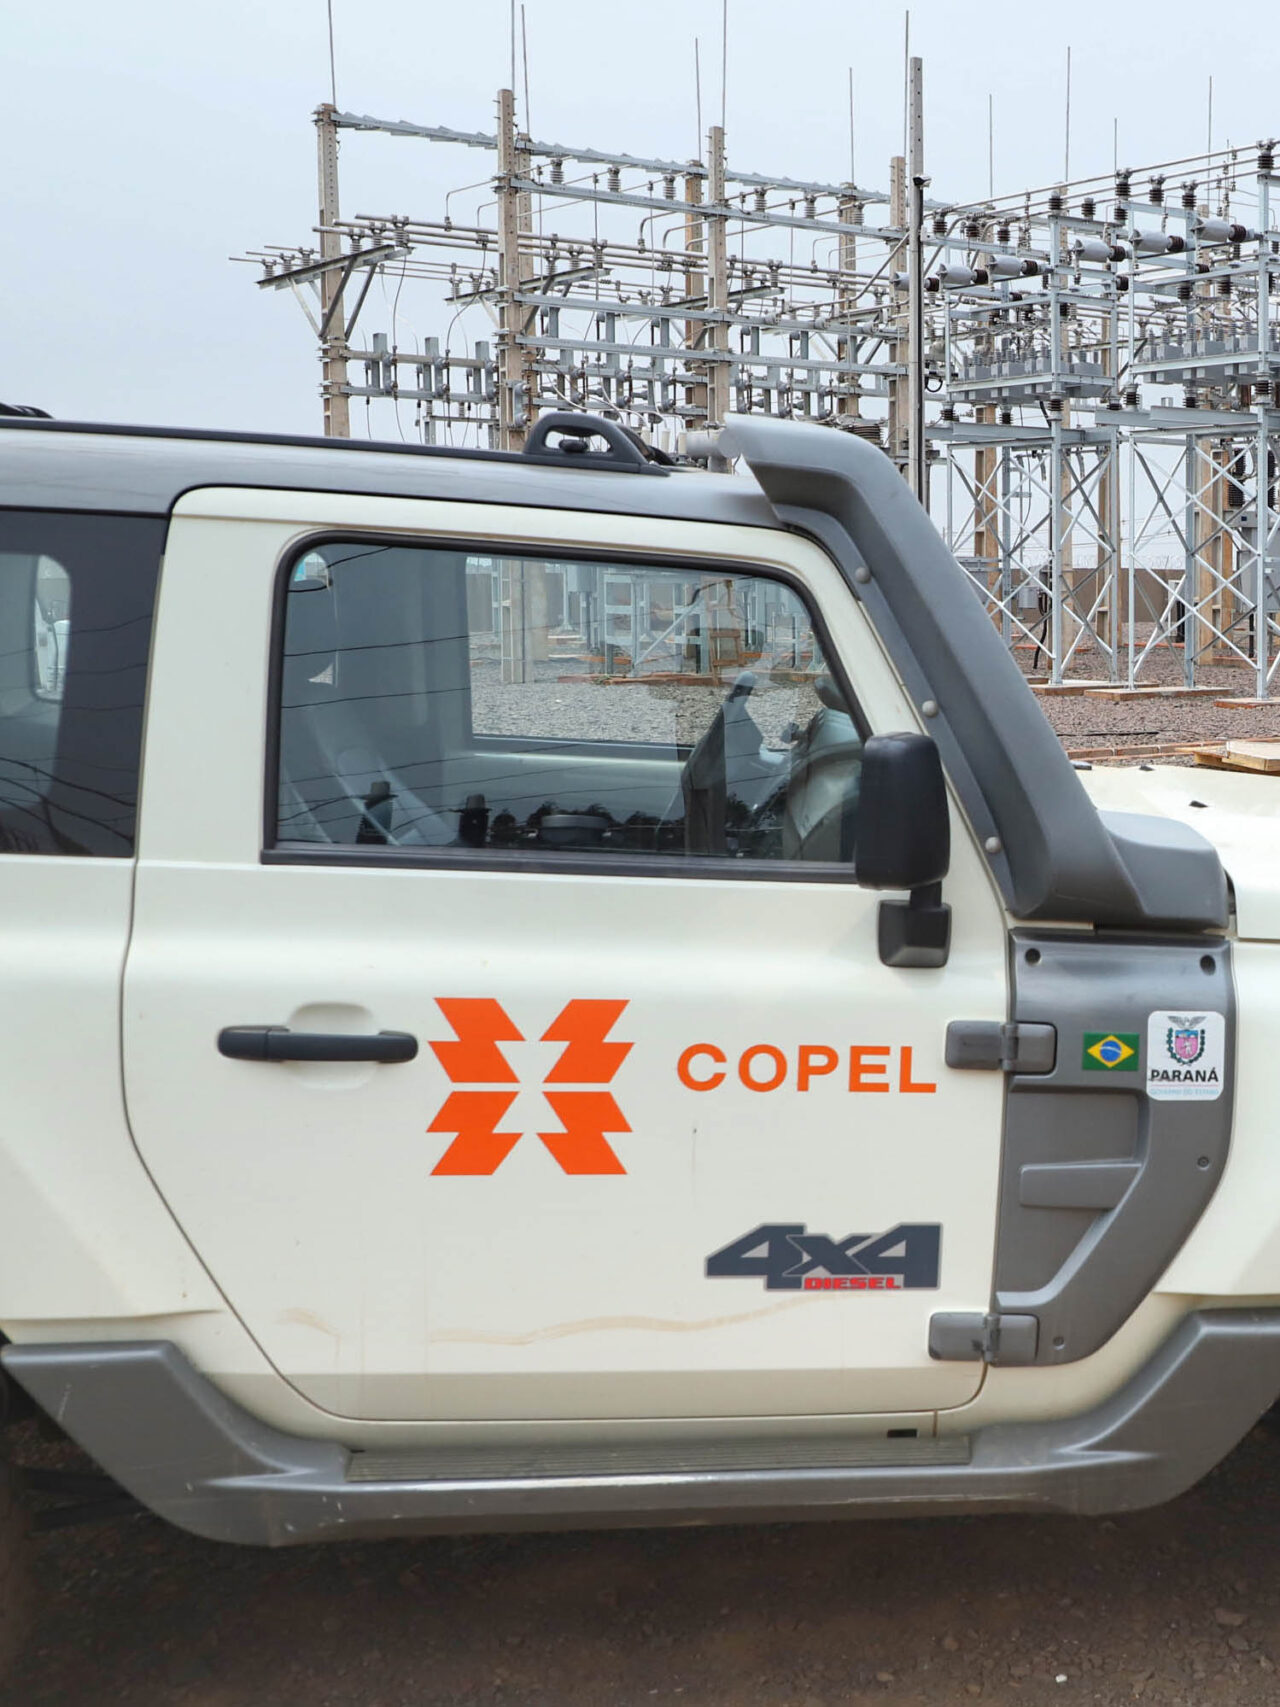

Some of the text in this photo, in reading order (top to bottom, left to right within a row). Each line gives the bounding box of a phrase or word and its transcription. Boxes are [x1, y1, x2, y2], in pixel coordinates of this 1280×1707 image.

[677, 1043, 937, 1093] COPEL
[1149, 1067, 1219, 1082] PARANÁ
[804, 1277, 901, 1290] DIESEL
